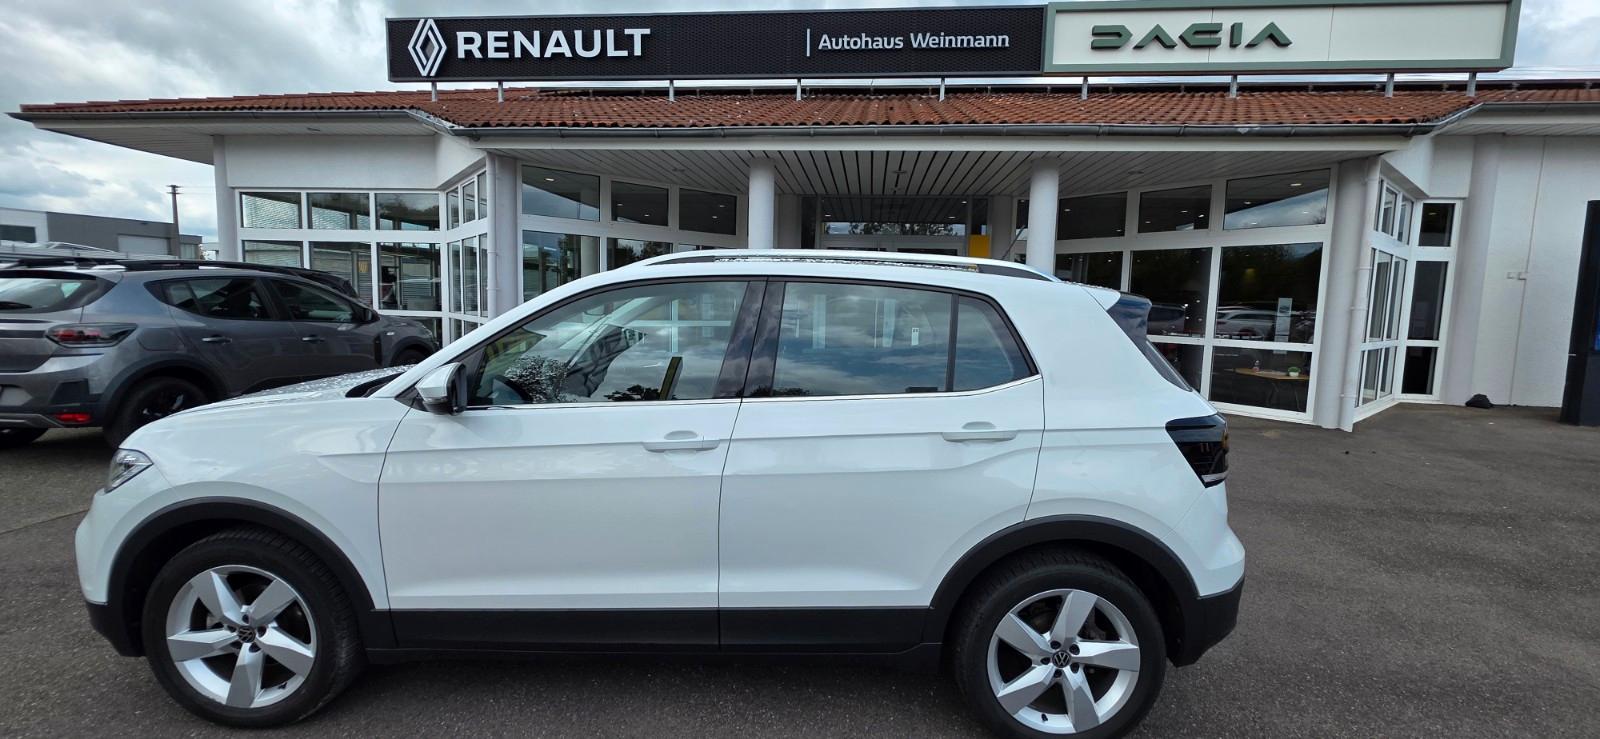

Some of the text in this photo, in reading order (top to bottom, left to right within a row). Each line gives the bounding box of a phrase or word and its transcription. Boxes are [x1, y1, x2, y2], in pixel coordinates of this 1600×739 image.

[456, 28, 650, 58] RENAULT
[818, 32, 1010, 49] Autohaus Weinmann
[1091, 22, 1292, 49] DACIA
